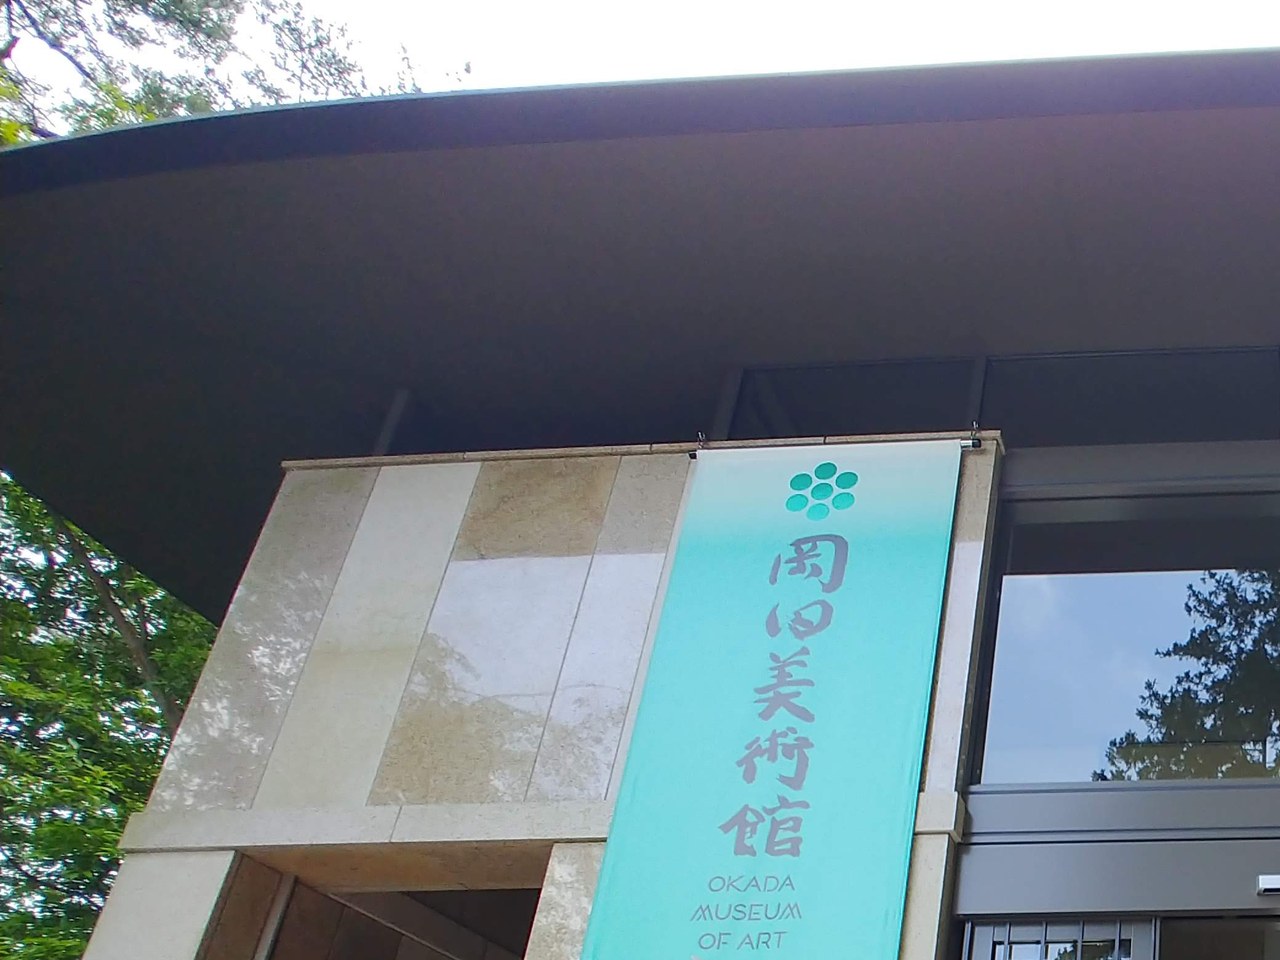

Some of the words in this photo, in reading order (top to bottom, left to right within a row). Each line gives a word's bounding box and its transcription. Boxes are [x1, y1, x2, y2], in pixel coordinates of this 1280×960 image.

[718, 533, 849, 858] 岡田美術館
[708, 875, 796, 892] OKADA
[690, 901, 802, 921] MUSEUM
[698, 932, 732, 950] OF
[737, 931, 788, 950] ART
